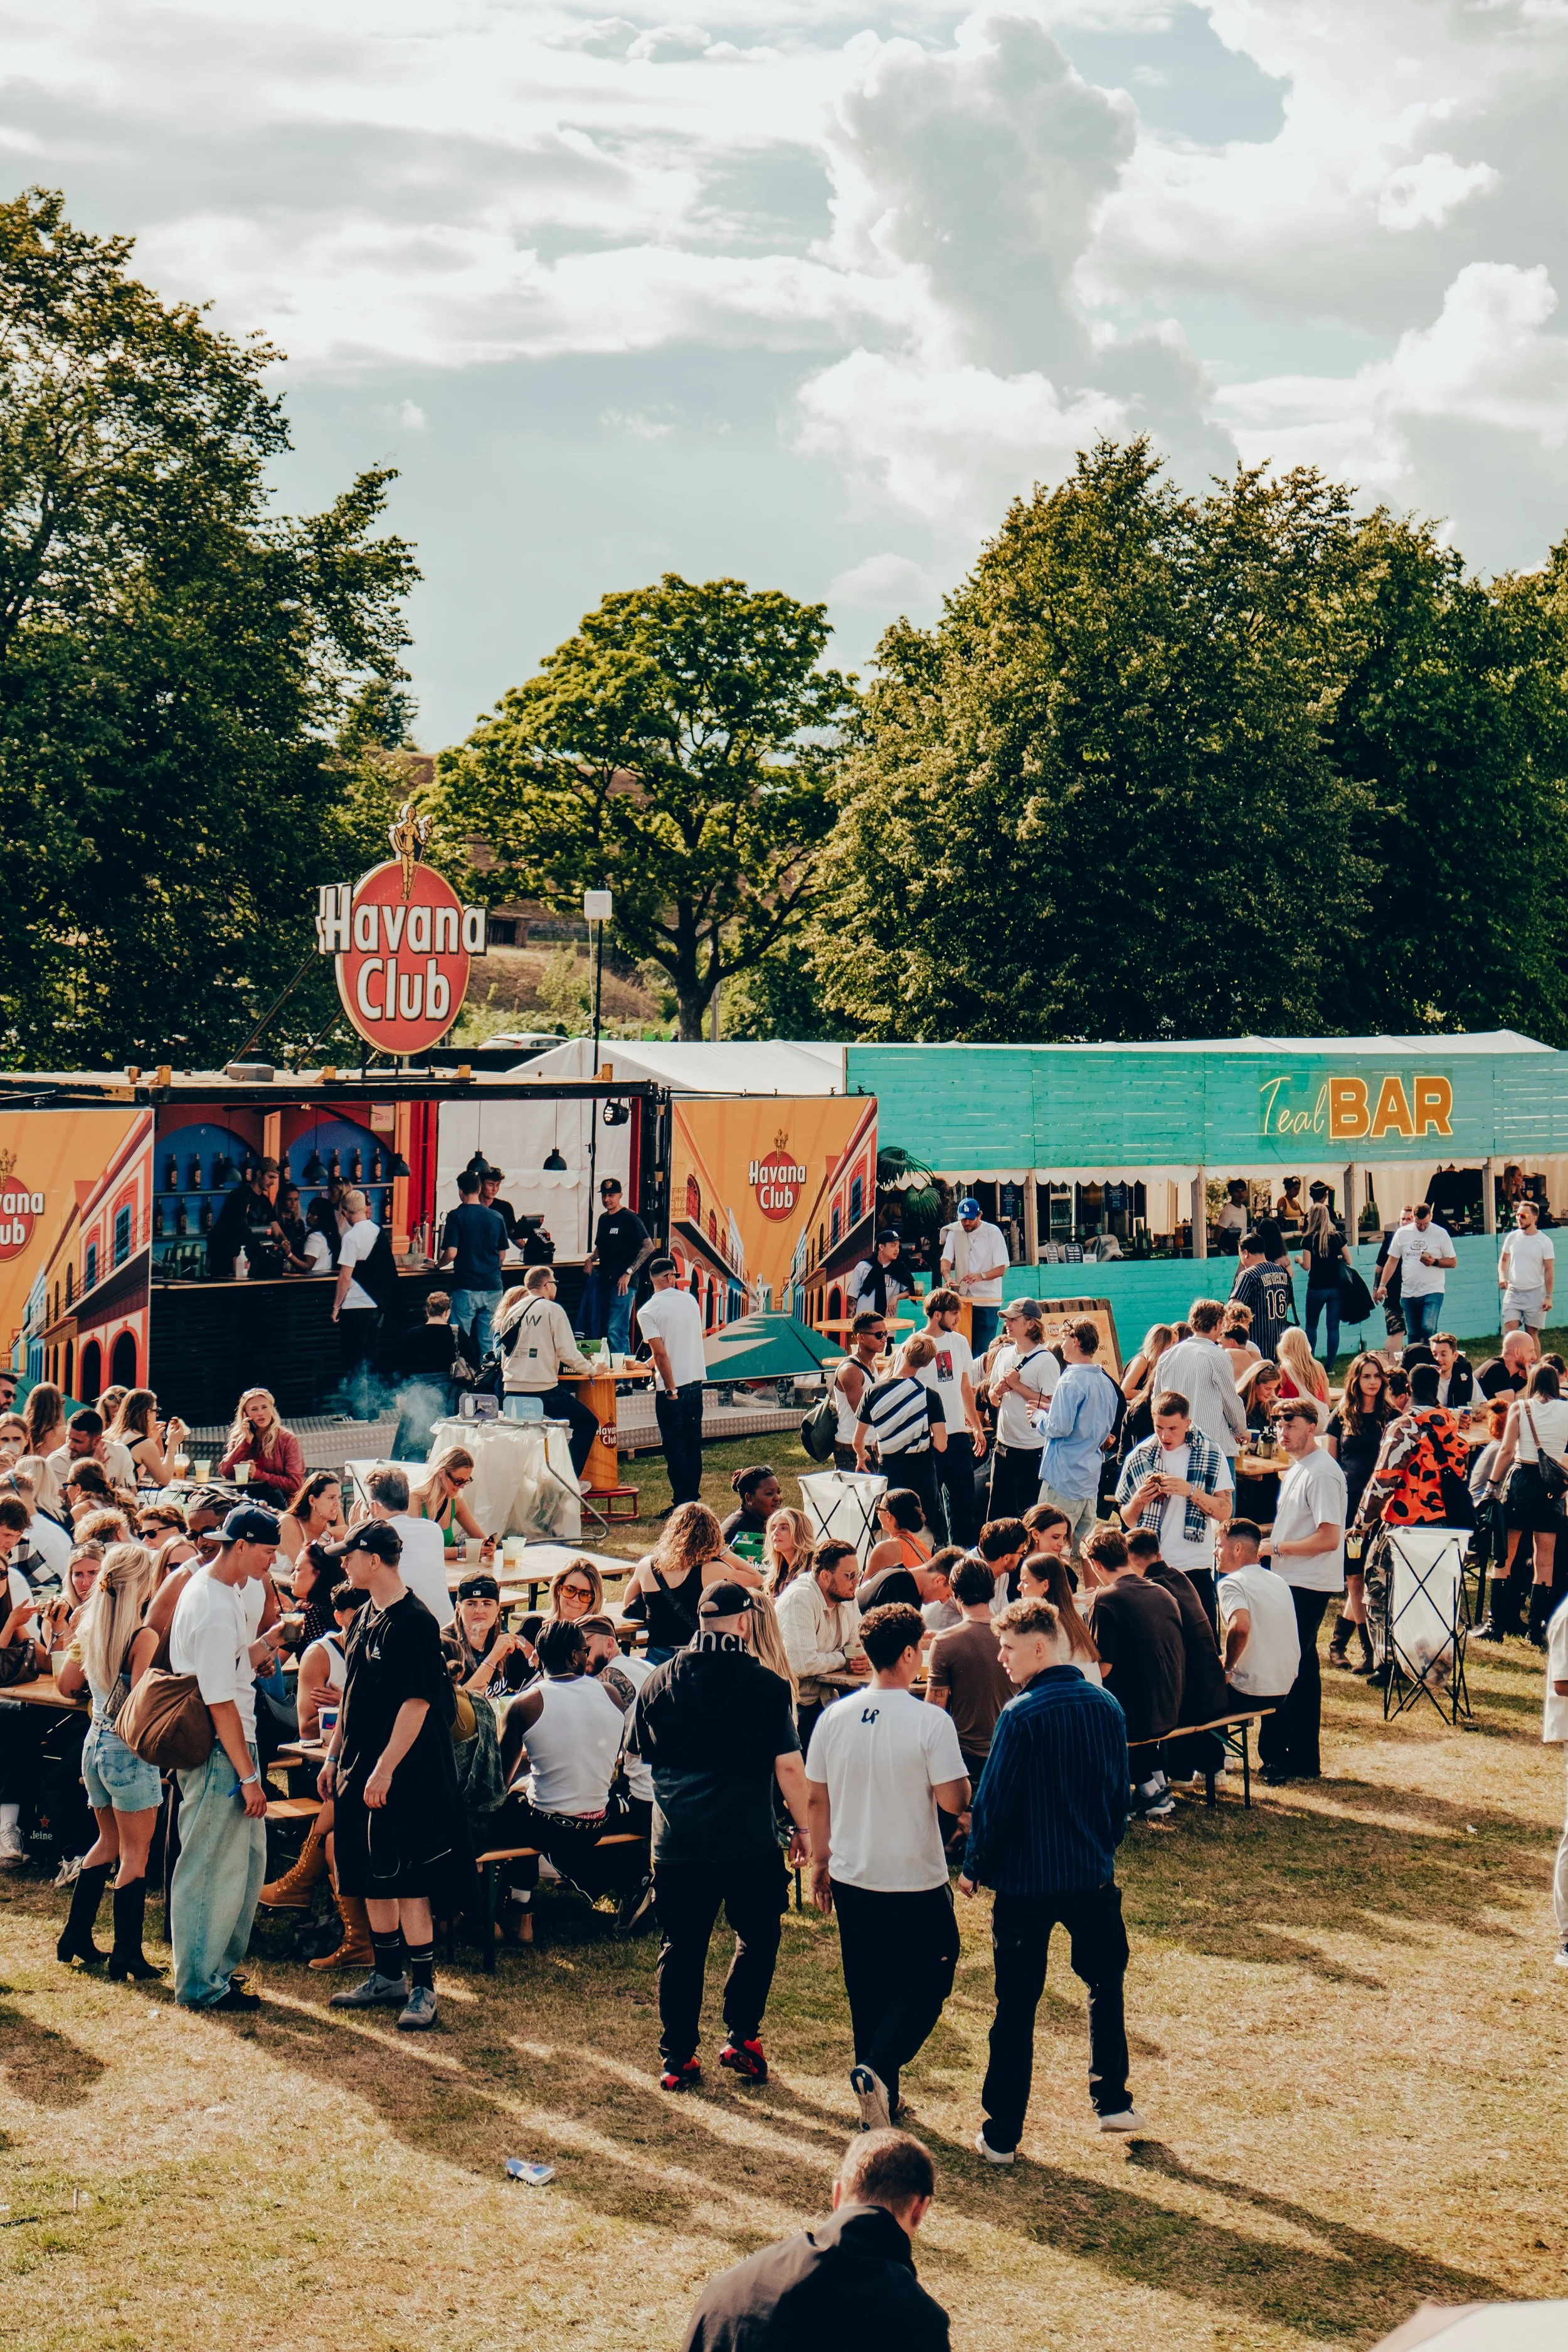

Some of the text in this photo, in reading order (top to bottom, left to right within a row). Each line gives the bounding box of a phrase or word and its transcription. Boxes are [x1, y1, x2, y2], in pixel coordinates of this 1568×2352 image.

[317, 883, 487, 956] Havana
[356, 956, 450, 1021] Club
[1259, 1076, 1454, 1139] Teal BAR
[748, 1158, 807, 1185] Havana
[760, 1184, 794, 1210] Club
[1261, 1272, 1288, 1287] OHTANI
[1266, 1288, 1287, 1320] 16
